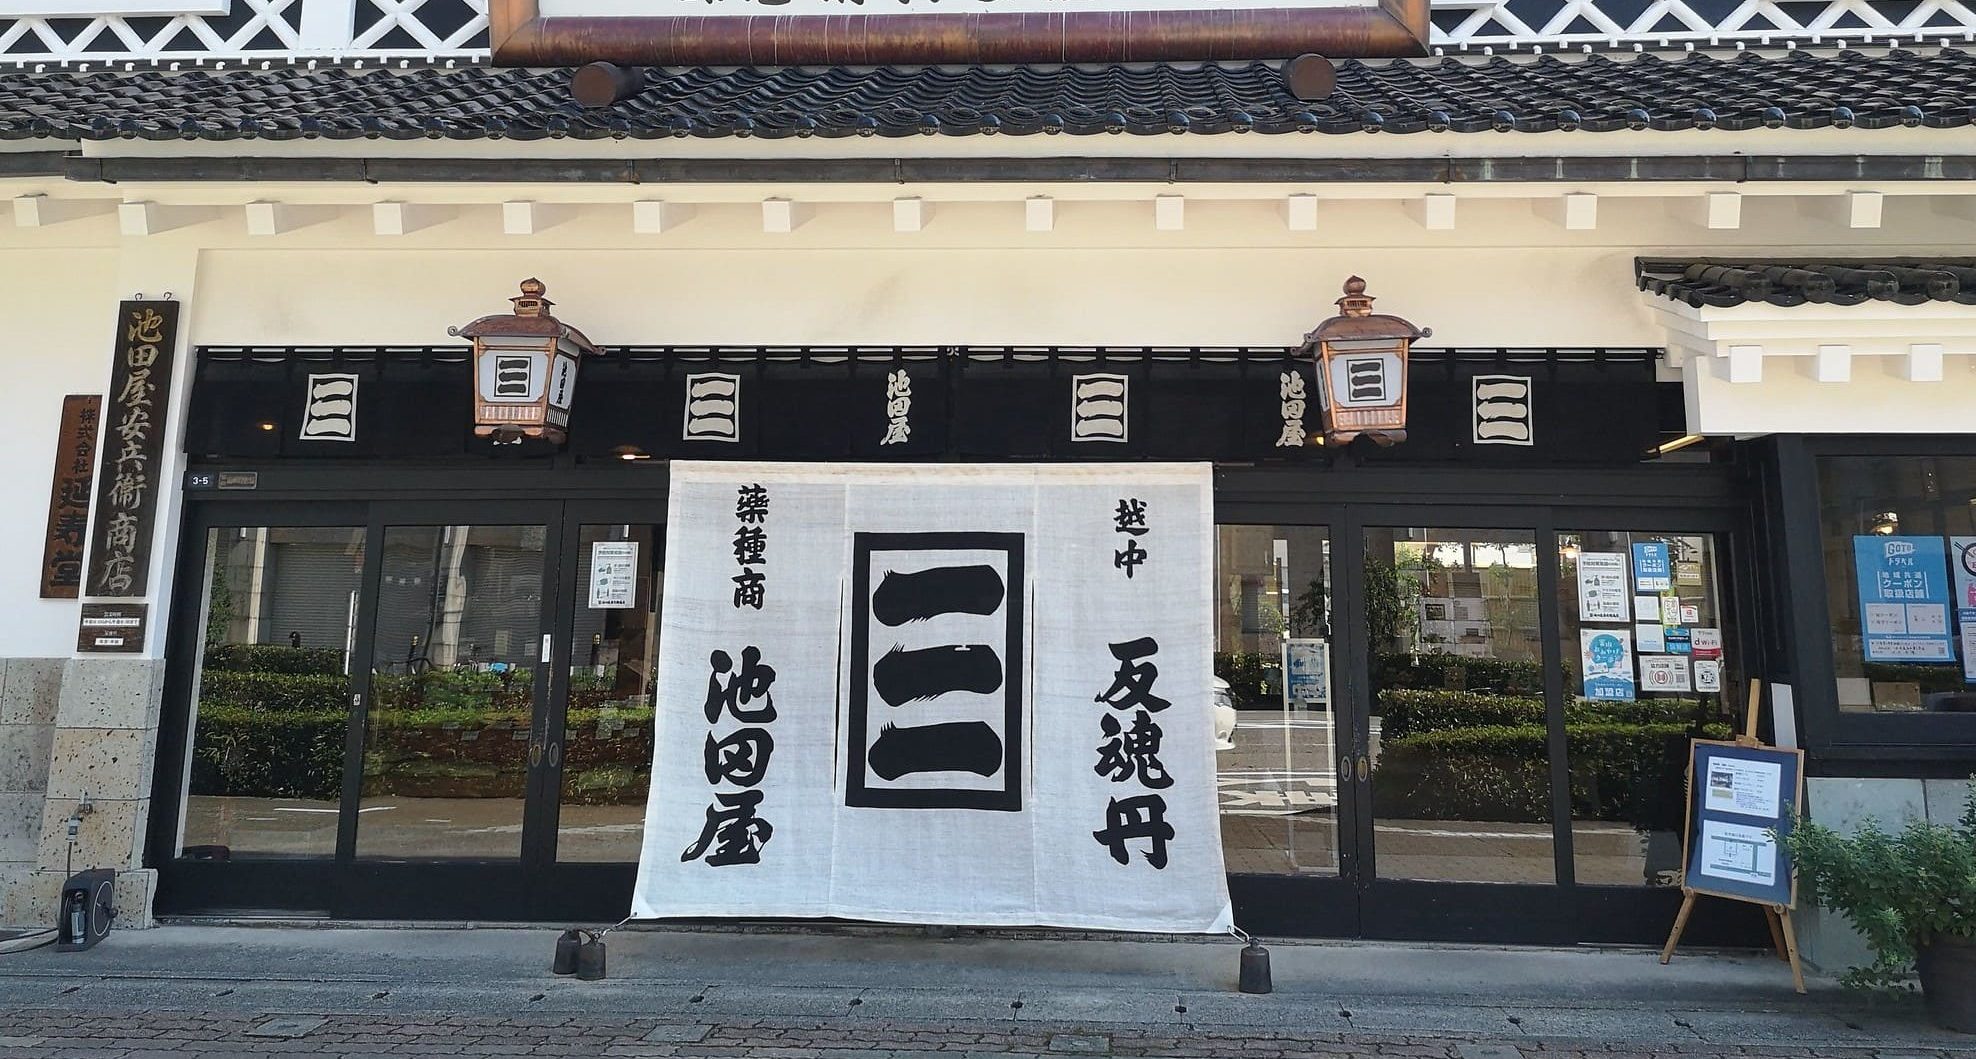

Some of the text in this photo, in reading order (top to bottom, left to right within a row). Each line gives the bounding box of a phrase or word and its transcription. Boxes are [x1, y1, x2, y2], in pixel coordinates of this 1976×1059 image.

[880, 369, 912, 446] 池田屋
[1275, 370, 1306, 447] 池田屋
[100, 308, 164, 592] 池田屋安兵衛商店
[192, 476, 209, 485] 3-5
[1882, 579, 1923, 588] クーポン
[1888, 558, 1914, 566] トラベル
[1093, 498, 1175, 869] 越中 反魂丹
[681, 646, 777, 867] 池田屋
